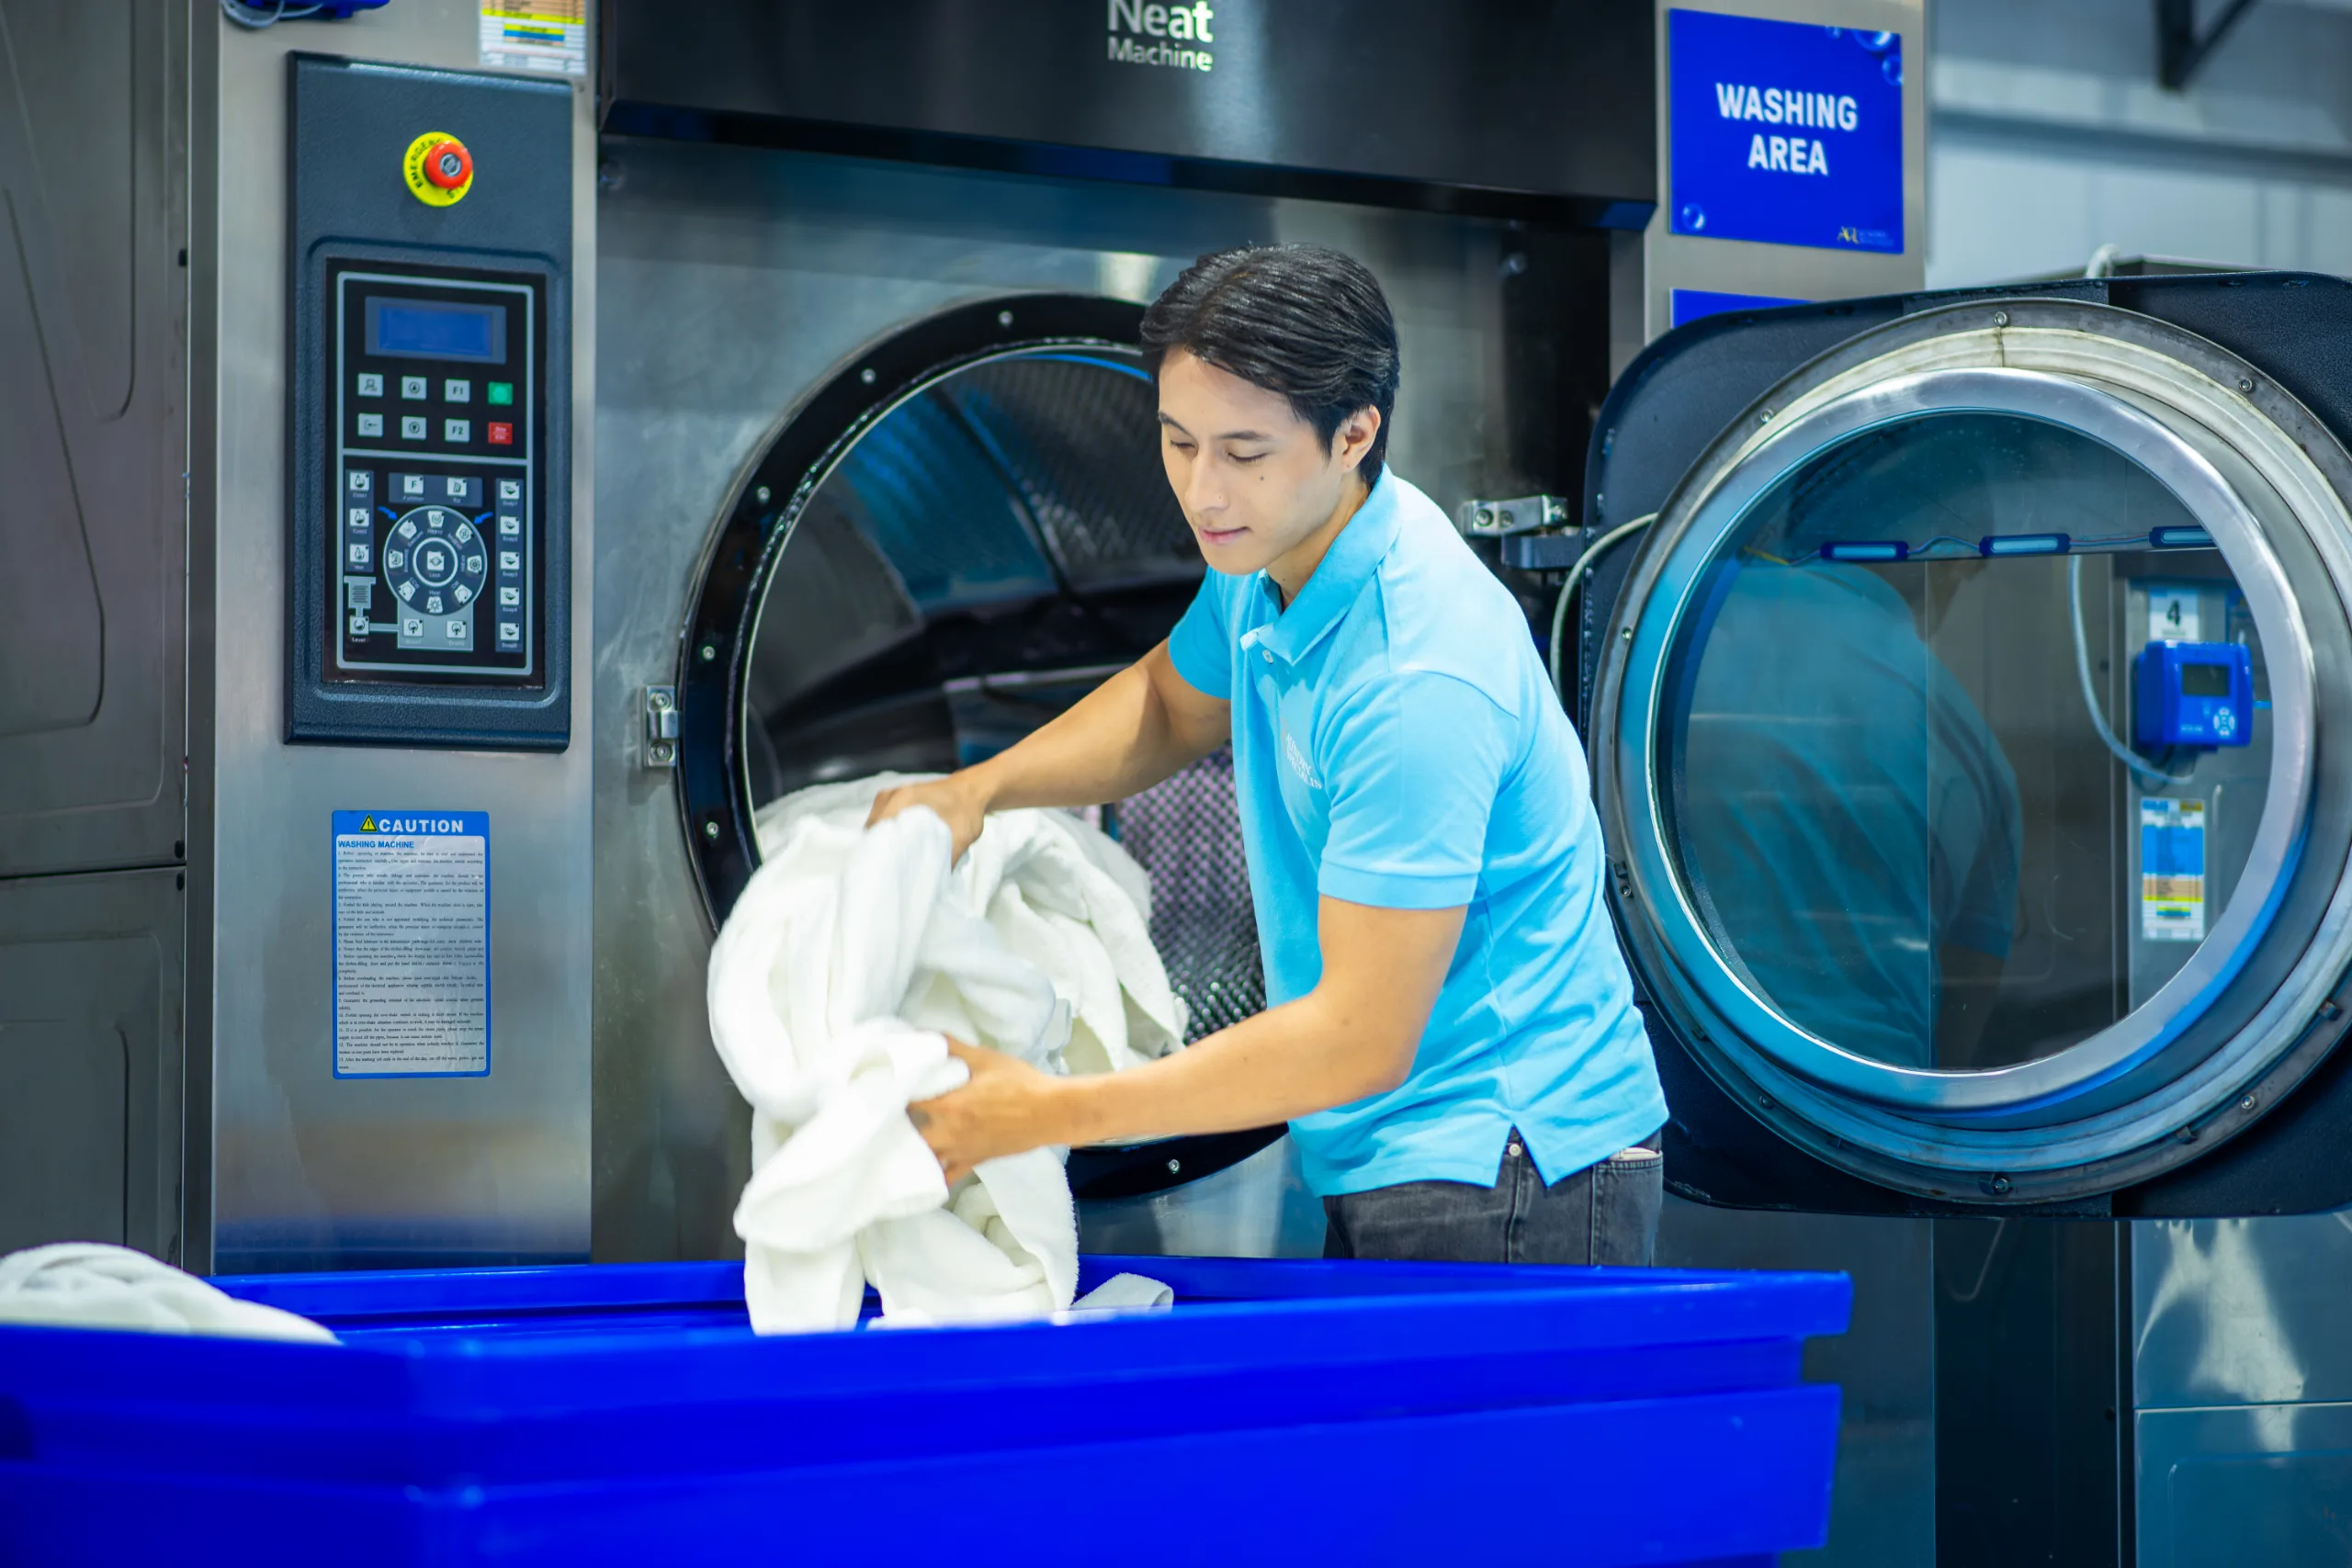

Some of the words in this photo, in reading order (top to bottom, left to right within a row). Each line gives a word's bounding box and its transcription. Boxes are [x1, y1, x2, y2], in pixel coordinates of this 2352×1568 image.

[1108, 0, 1214, 42] Neat
[1108, 37, 1213, 72] Machine
[1715, 83, 1858, 130] WASHING
[1747, 134, 1828, 175] AREA
[453, 386, 463, 395] F1
[452, 426, 463, 435] F2
[2166, 599, 2181, 626] 4
[379, 818, 464, 833] CAUTION
[378, 840, 414, 849] MACHINE
